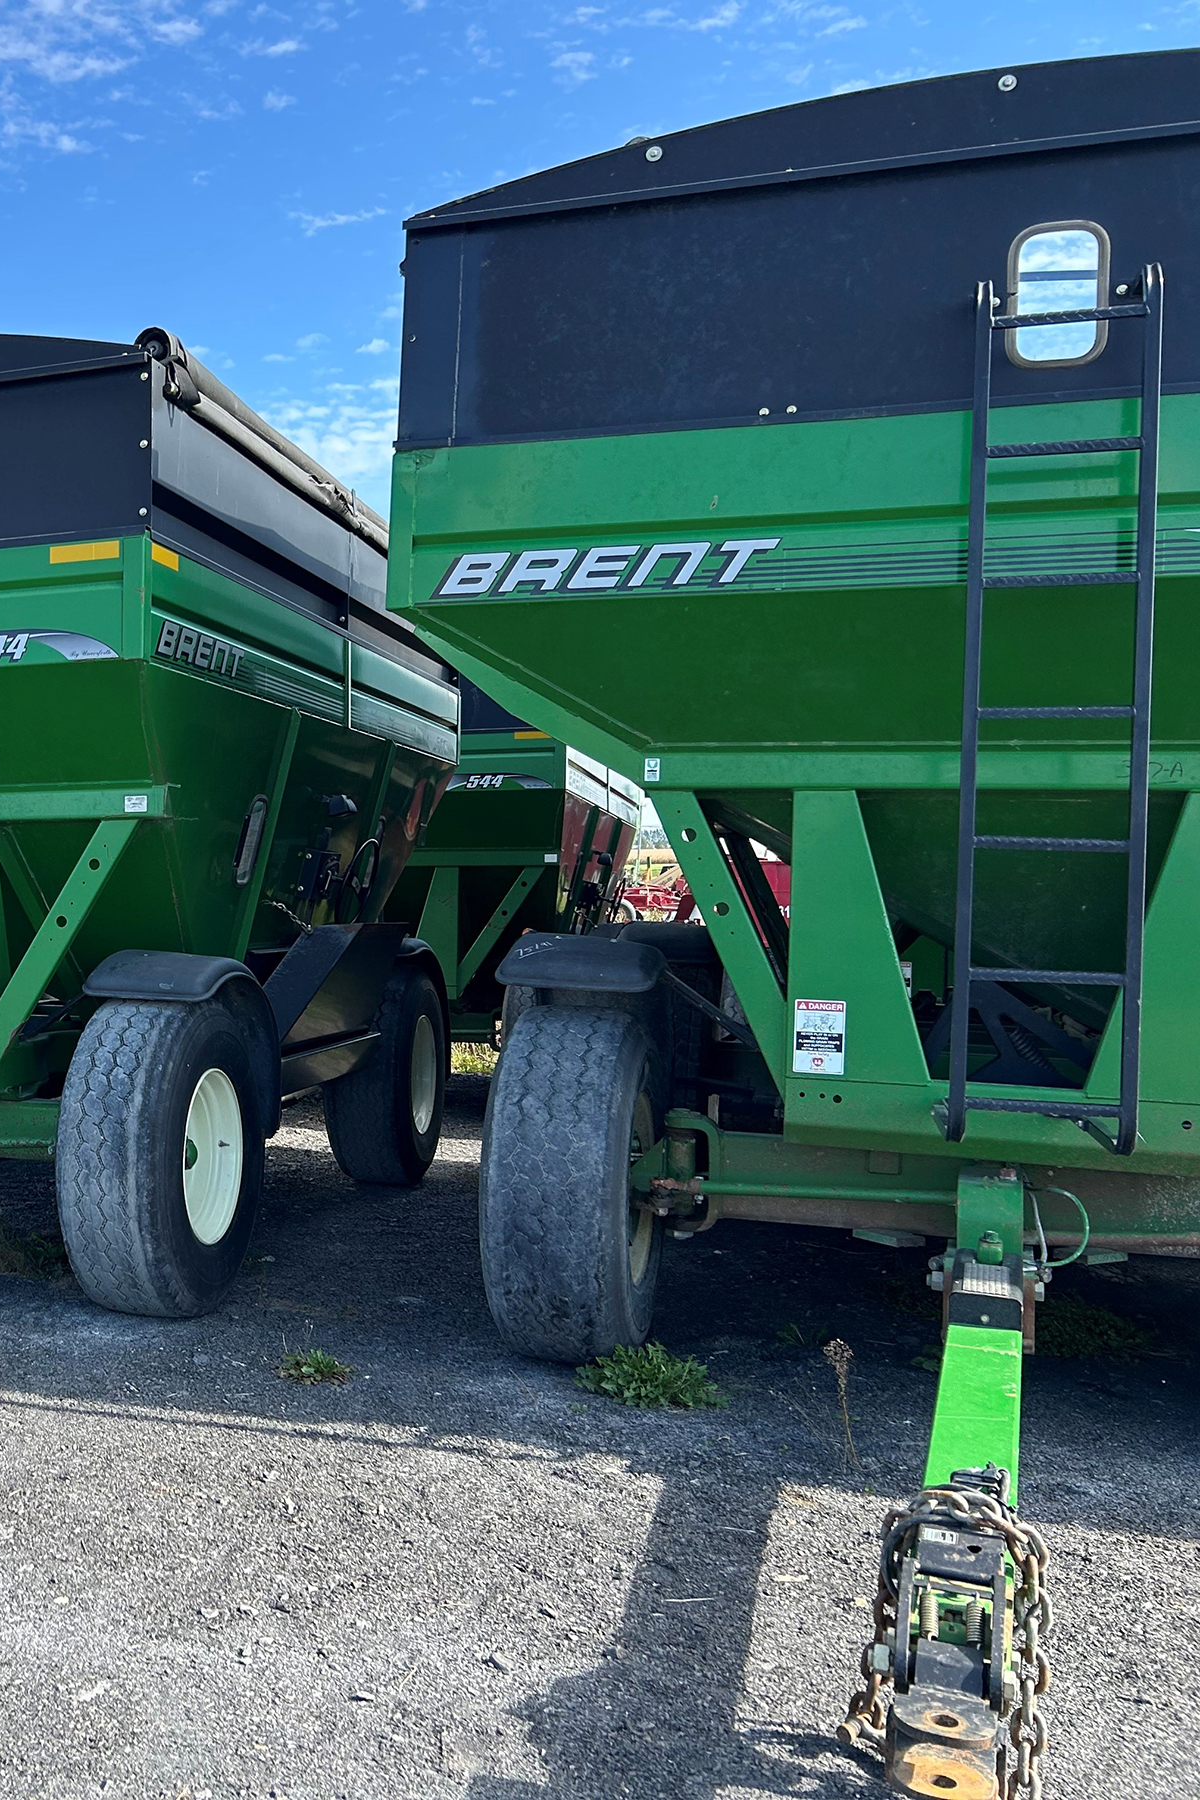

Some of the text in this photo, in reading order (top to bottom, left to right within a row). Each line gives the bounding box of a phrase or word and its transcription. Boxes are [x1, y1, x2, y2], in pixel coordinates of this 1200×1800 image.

[434, 537, 782, 598] BRENT
[155, 619, 245, 679] BRENT
[466, 774, 504, 789] 544
[808, 1002, 843, 1011] DANGER
